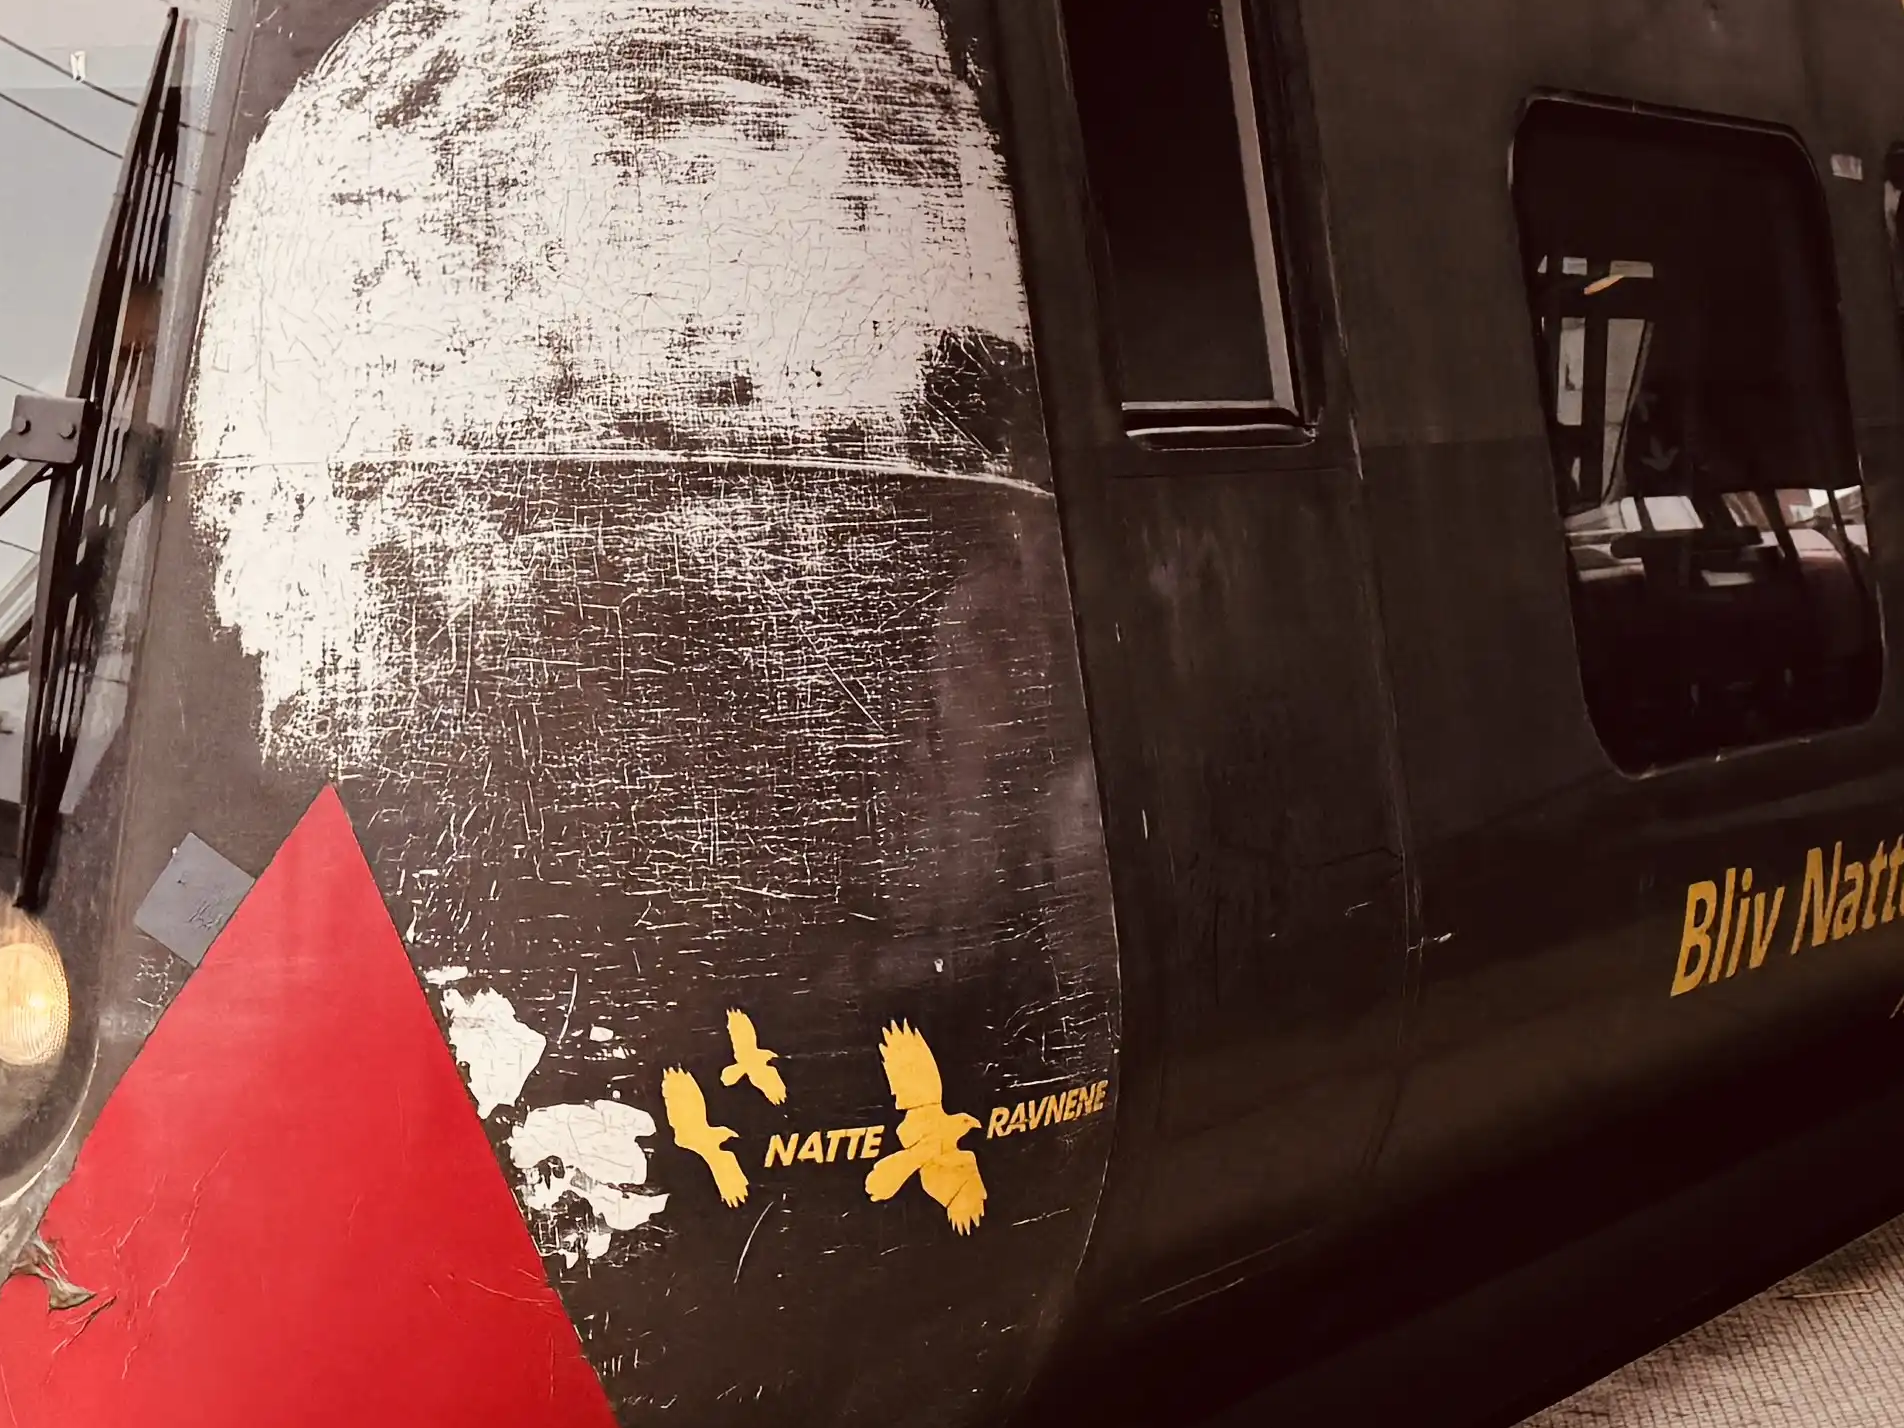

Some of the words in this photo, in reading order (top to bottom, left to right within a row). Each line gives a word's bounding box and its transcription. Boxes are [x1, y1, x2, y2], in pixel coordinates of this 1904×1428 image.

[1669, 866, 1786, 998] Bliv
[763, 1124, 885, 1169] NATTE
[986, 1078, 1109, 1140] RAVNENE
